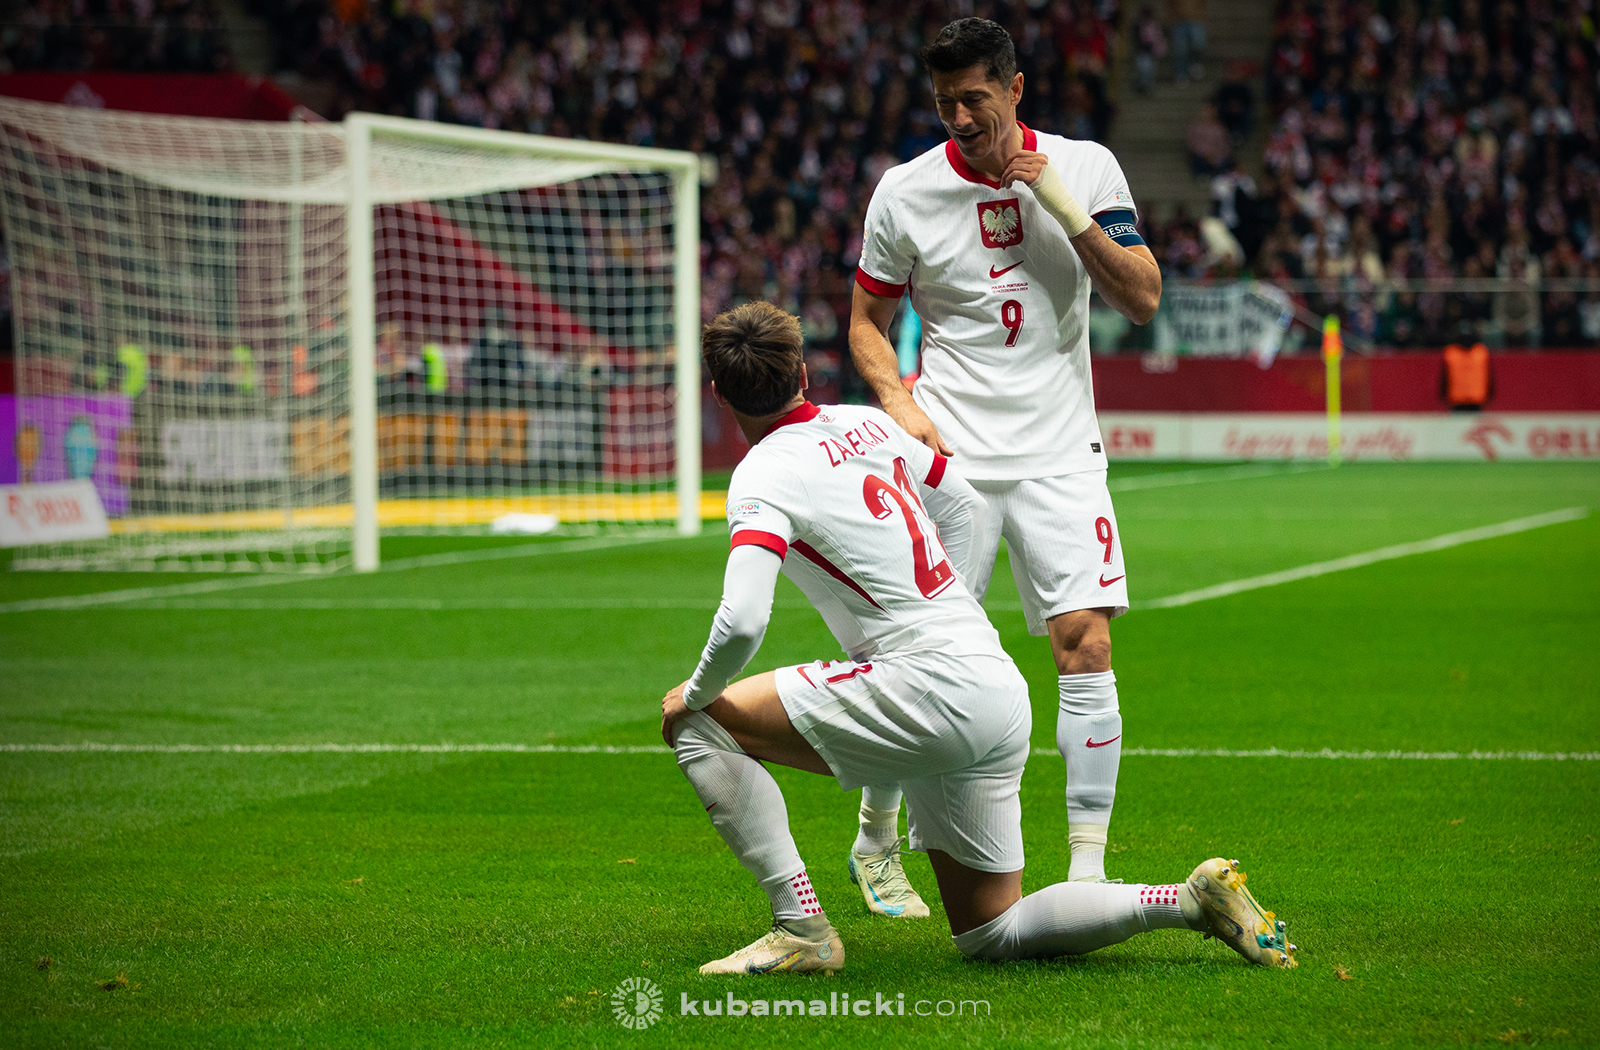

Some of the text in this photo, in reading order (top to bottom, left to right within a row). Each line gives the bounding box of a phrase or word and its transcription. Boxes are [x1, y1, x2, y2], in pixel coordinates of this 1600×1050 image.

[1104, 225, 1137, 237] RESPEC
[1001, 299, 1025, 347] 9
[1095, 516, 1115, 565] 9
